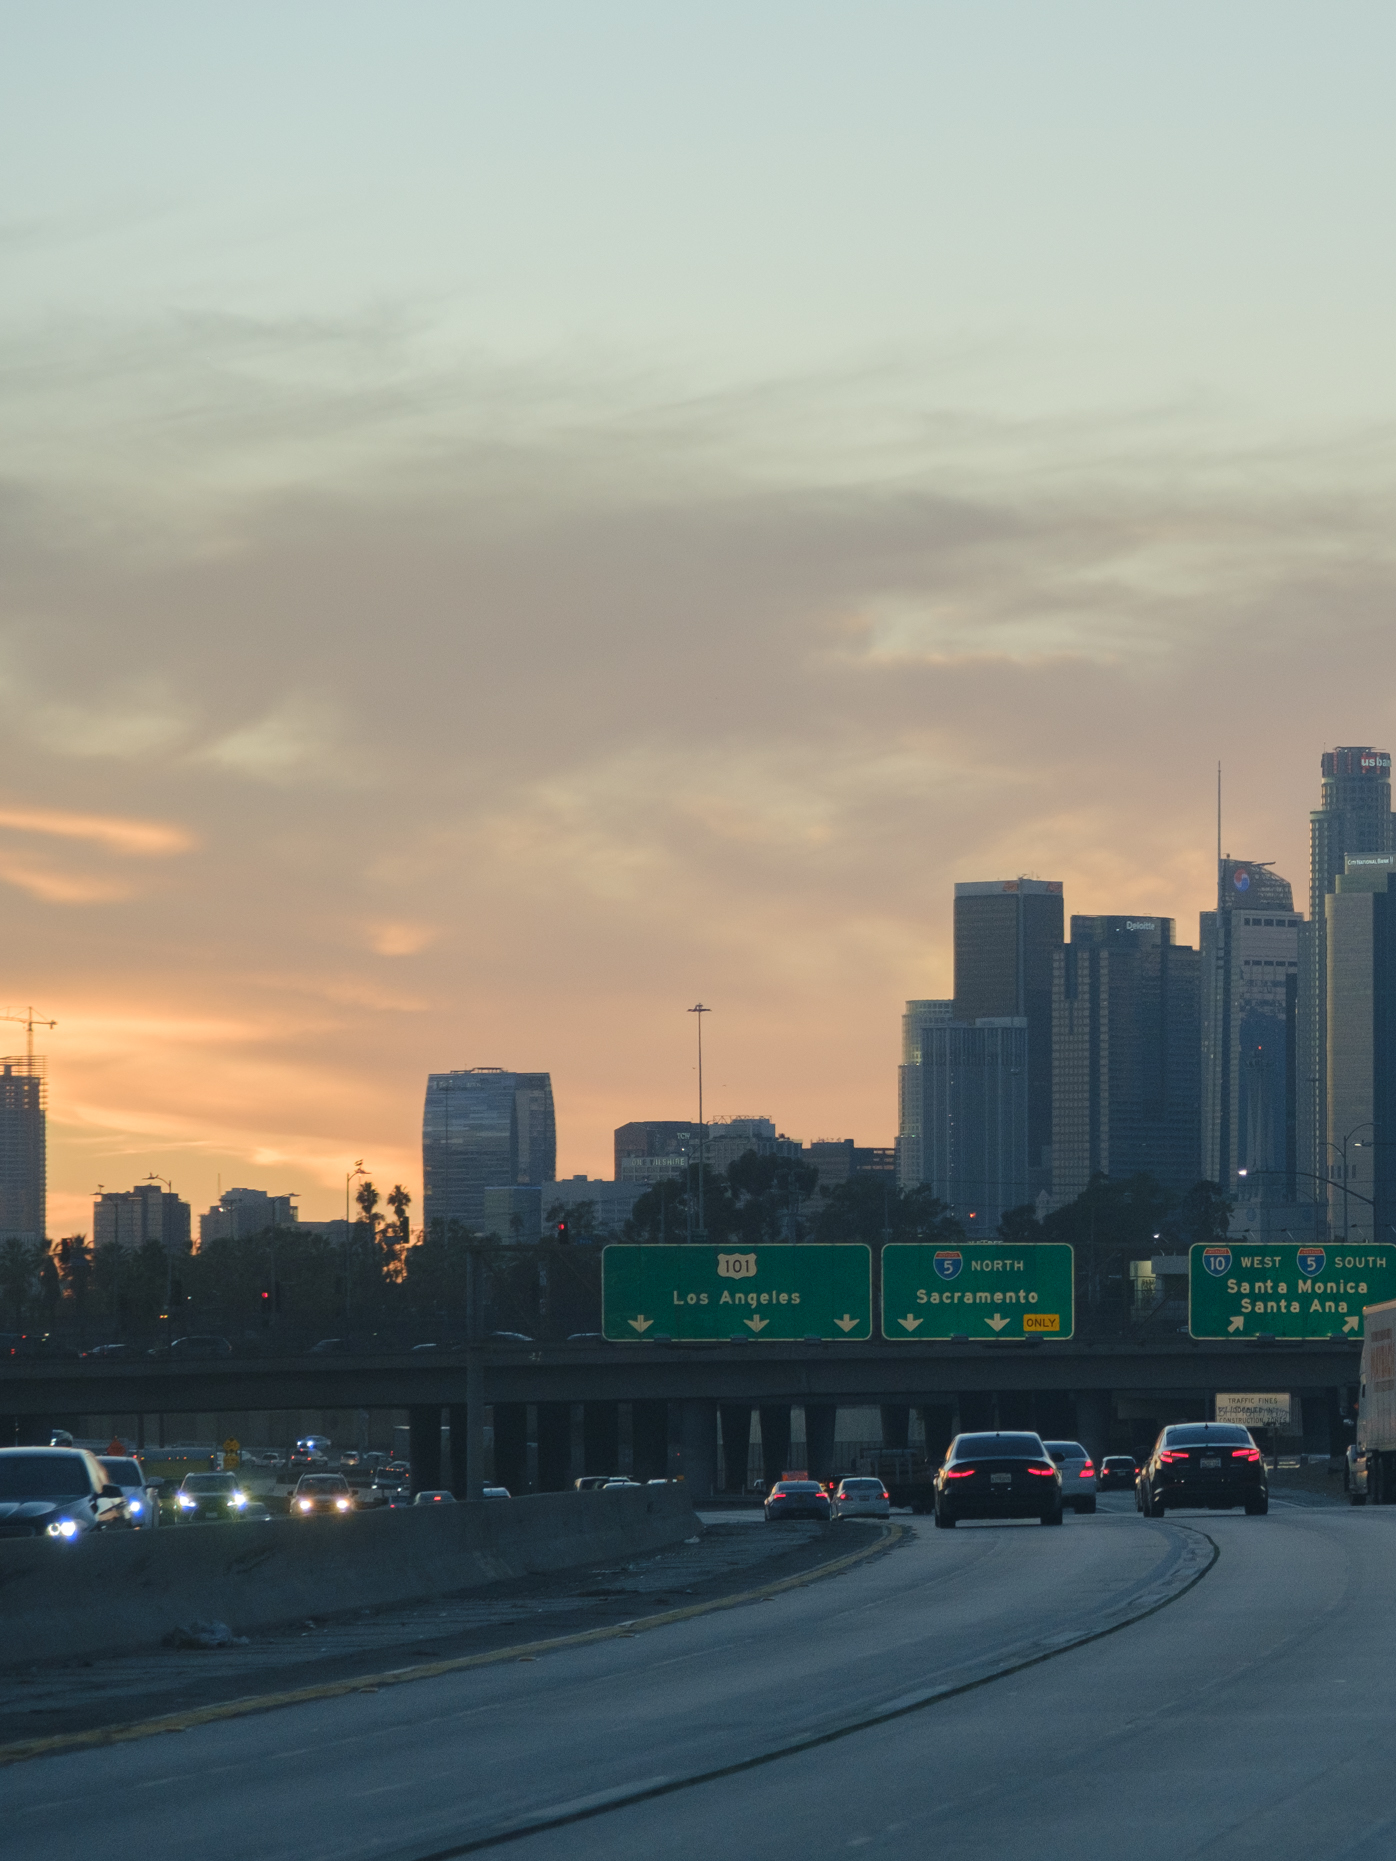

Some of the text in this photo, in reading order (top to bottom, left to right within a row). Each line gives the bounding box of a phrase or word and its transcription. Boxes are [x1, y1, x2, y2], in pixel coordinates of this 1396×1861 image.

[1126, 921, 1154, 931] Deloitte
[650, 1158, 684, 1166] WILSHIRE
[725, 1260, 749, 1273] 101
[944, 1260, 1024, 1274] 5 NORTH
[1210, 1257, 1281, 1271] 10 WEST
[1306, 1257, 1386, 1271] 5 SOUTH
[1227, 1279, 1368, 1293] Santa Monica
[674, 1290, 800, 1309] Los Angeles
[916, 1289, 1038, 1304] Sacramento
[1241, 1298, 1347, 1313] Santa Ana
[1026, 1318, 1056, 1327] ONLY
